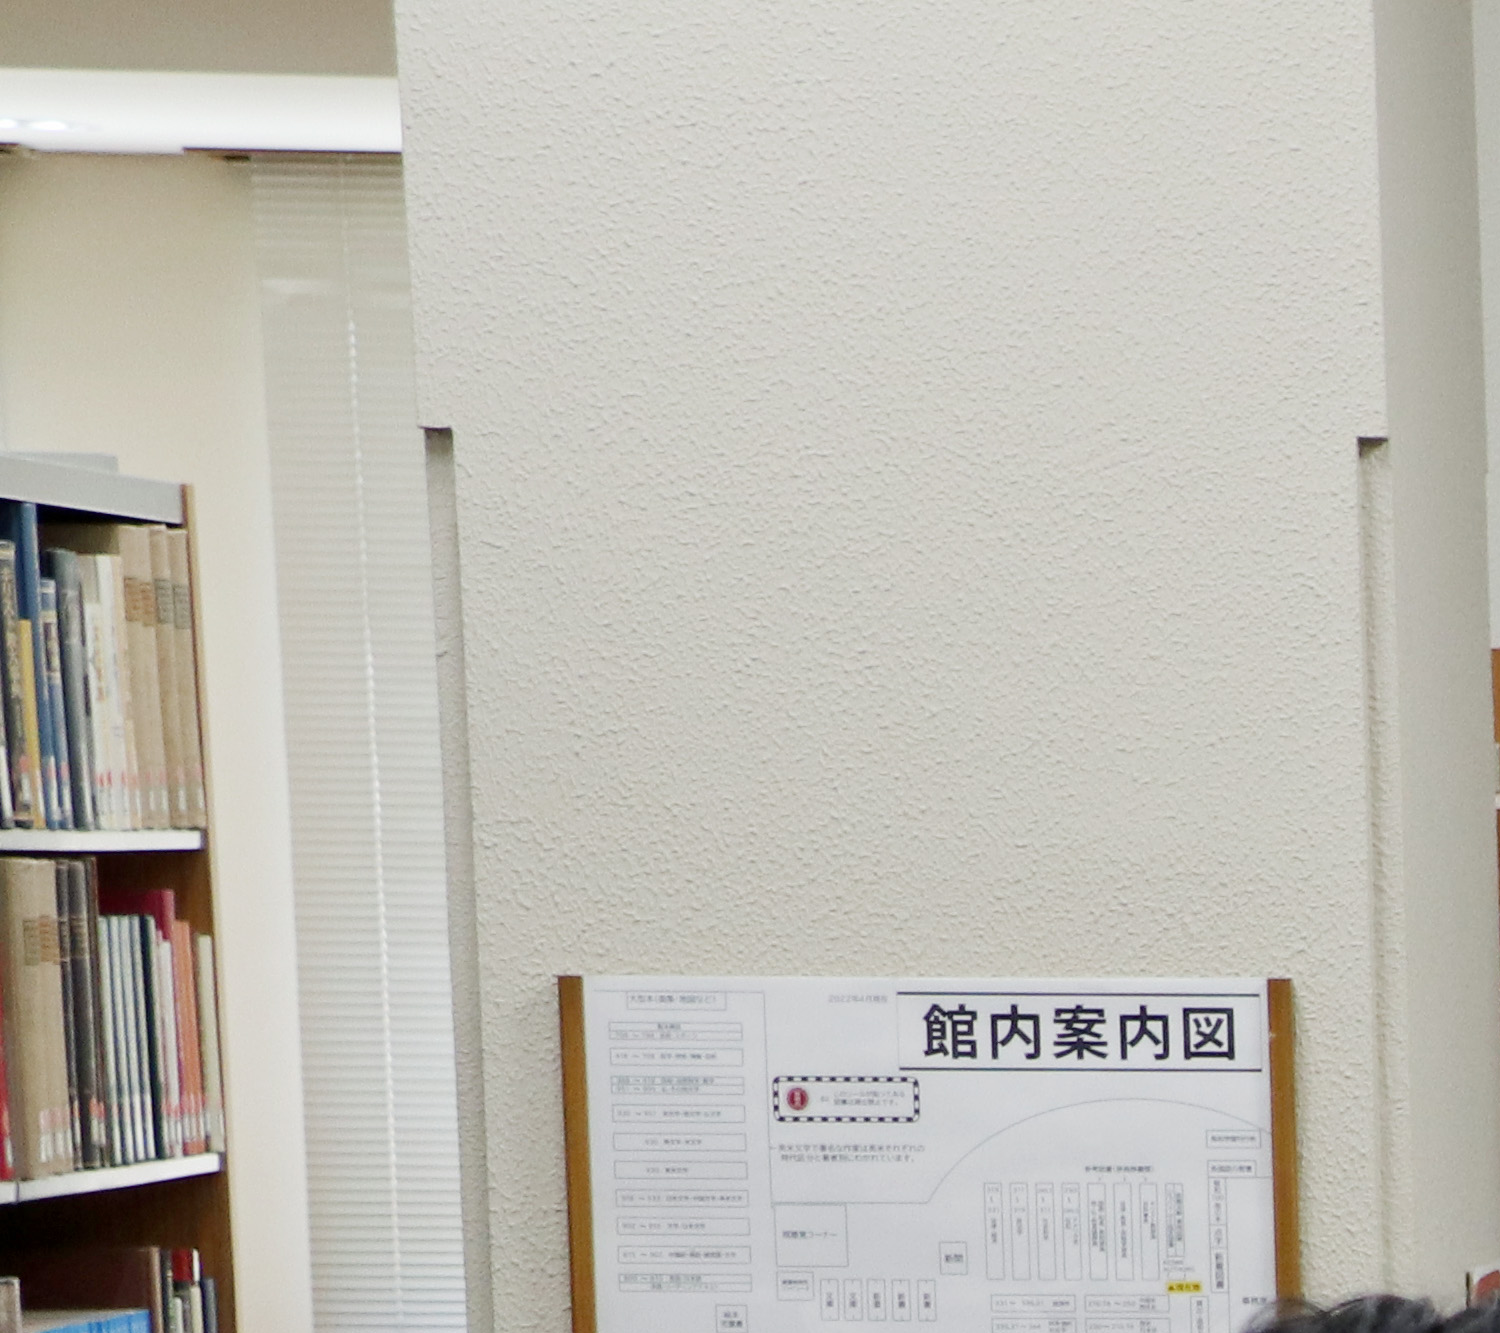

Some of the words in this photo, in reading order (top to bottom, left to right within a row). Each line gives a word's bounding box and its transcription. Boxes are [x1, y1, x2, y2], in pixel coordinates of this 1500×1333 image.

[923, 1003, 1236, 1061] 館内案内図
